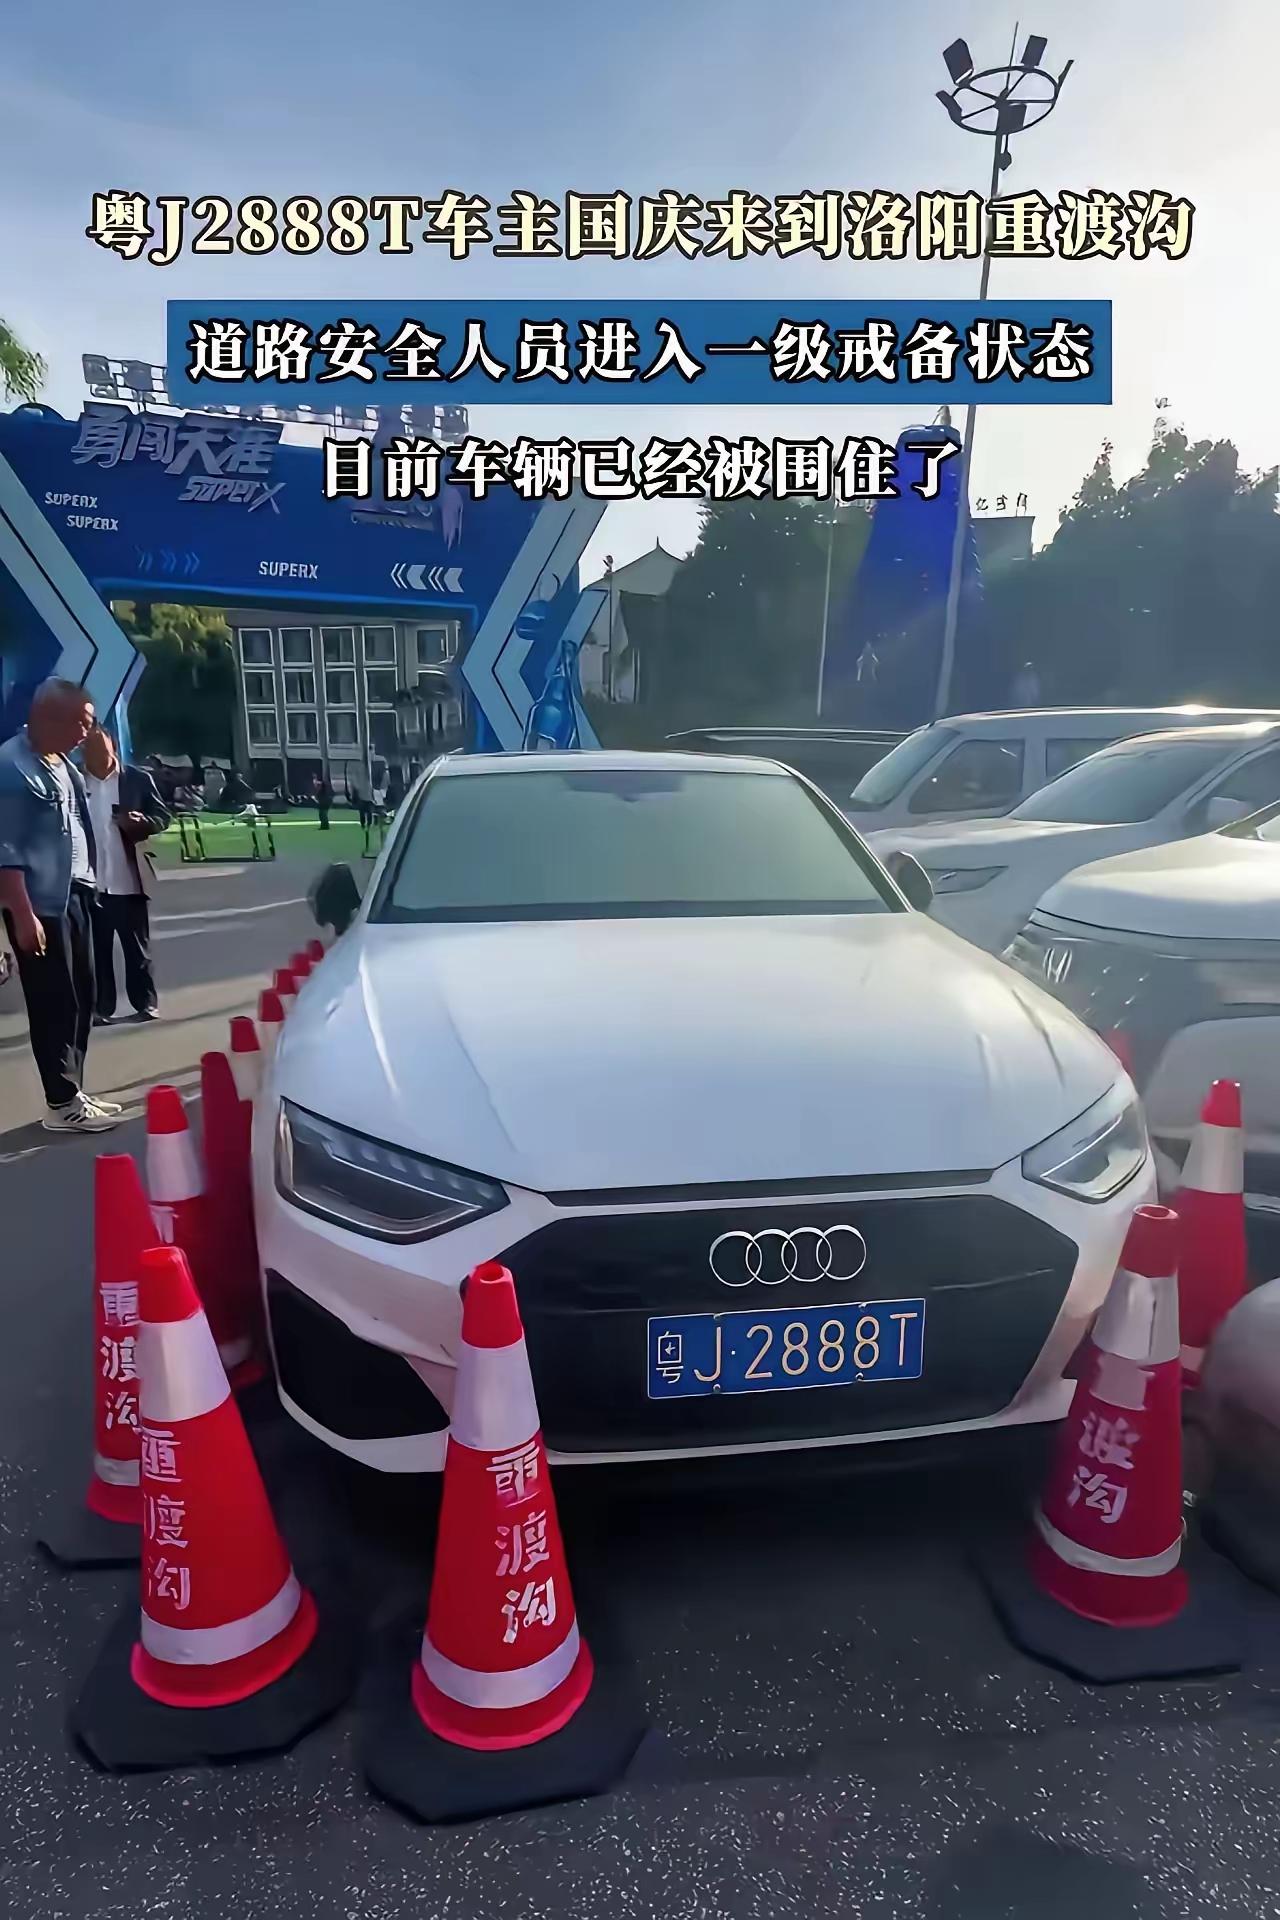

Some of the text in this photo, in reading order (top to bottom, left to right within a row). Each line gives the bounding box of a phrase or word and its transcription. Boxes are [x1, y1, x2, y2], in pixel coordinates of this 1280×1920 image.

[71, 413, 278, 475] 勇闯天涯
[258, 561, 319, 580] SUPERX
